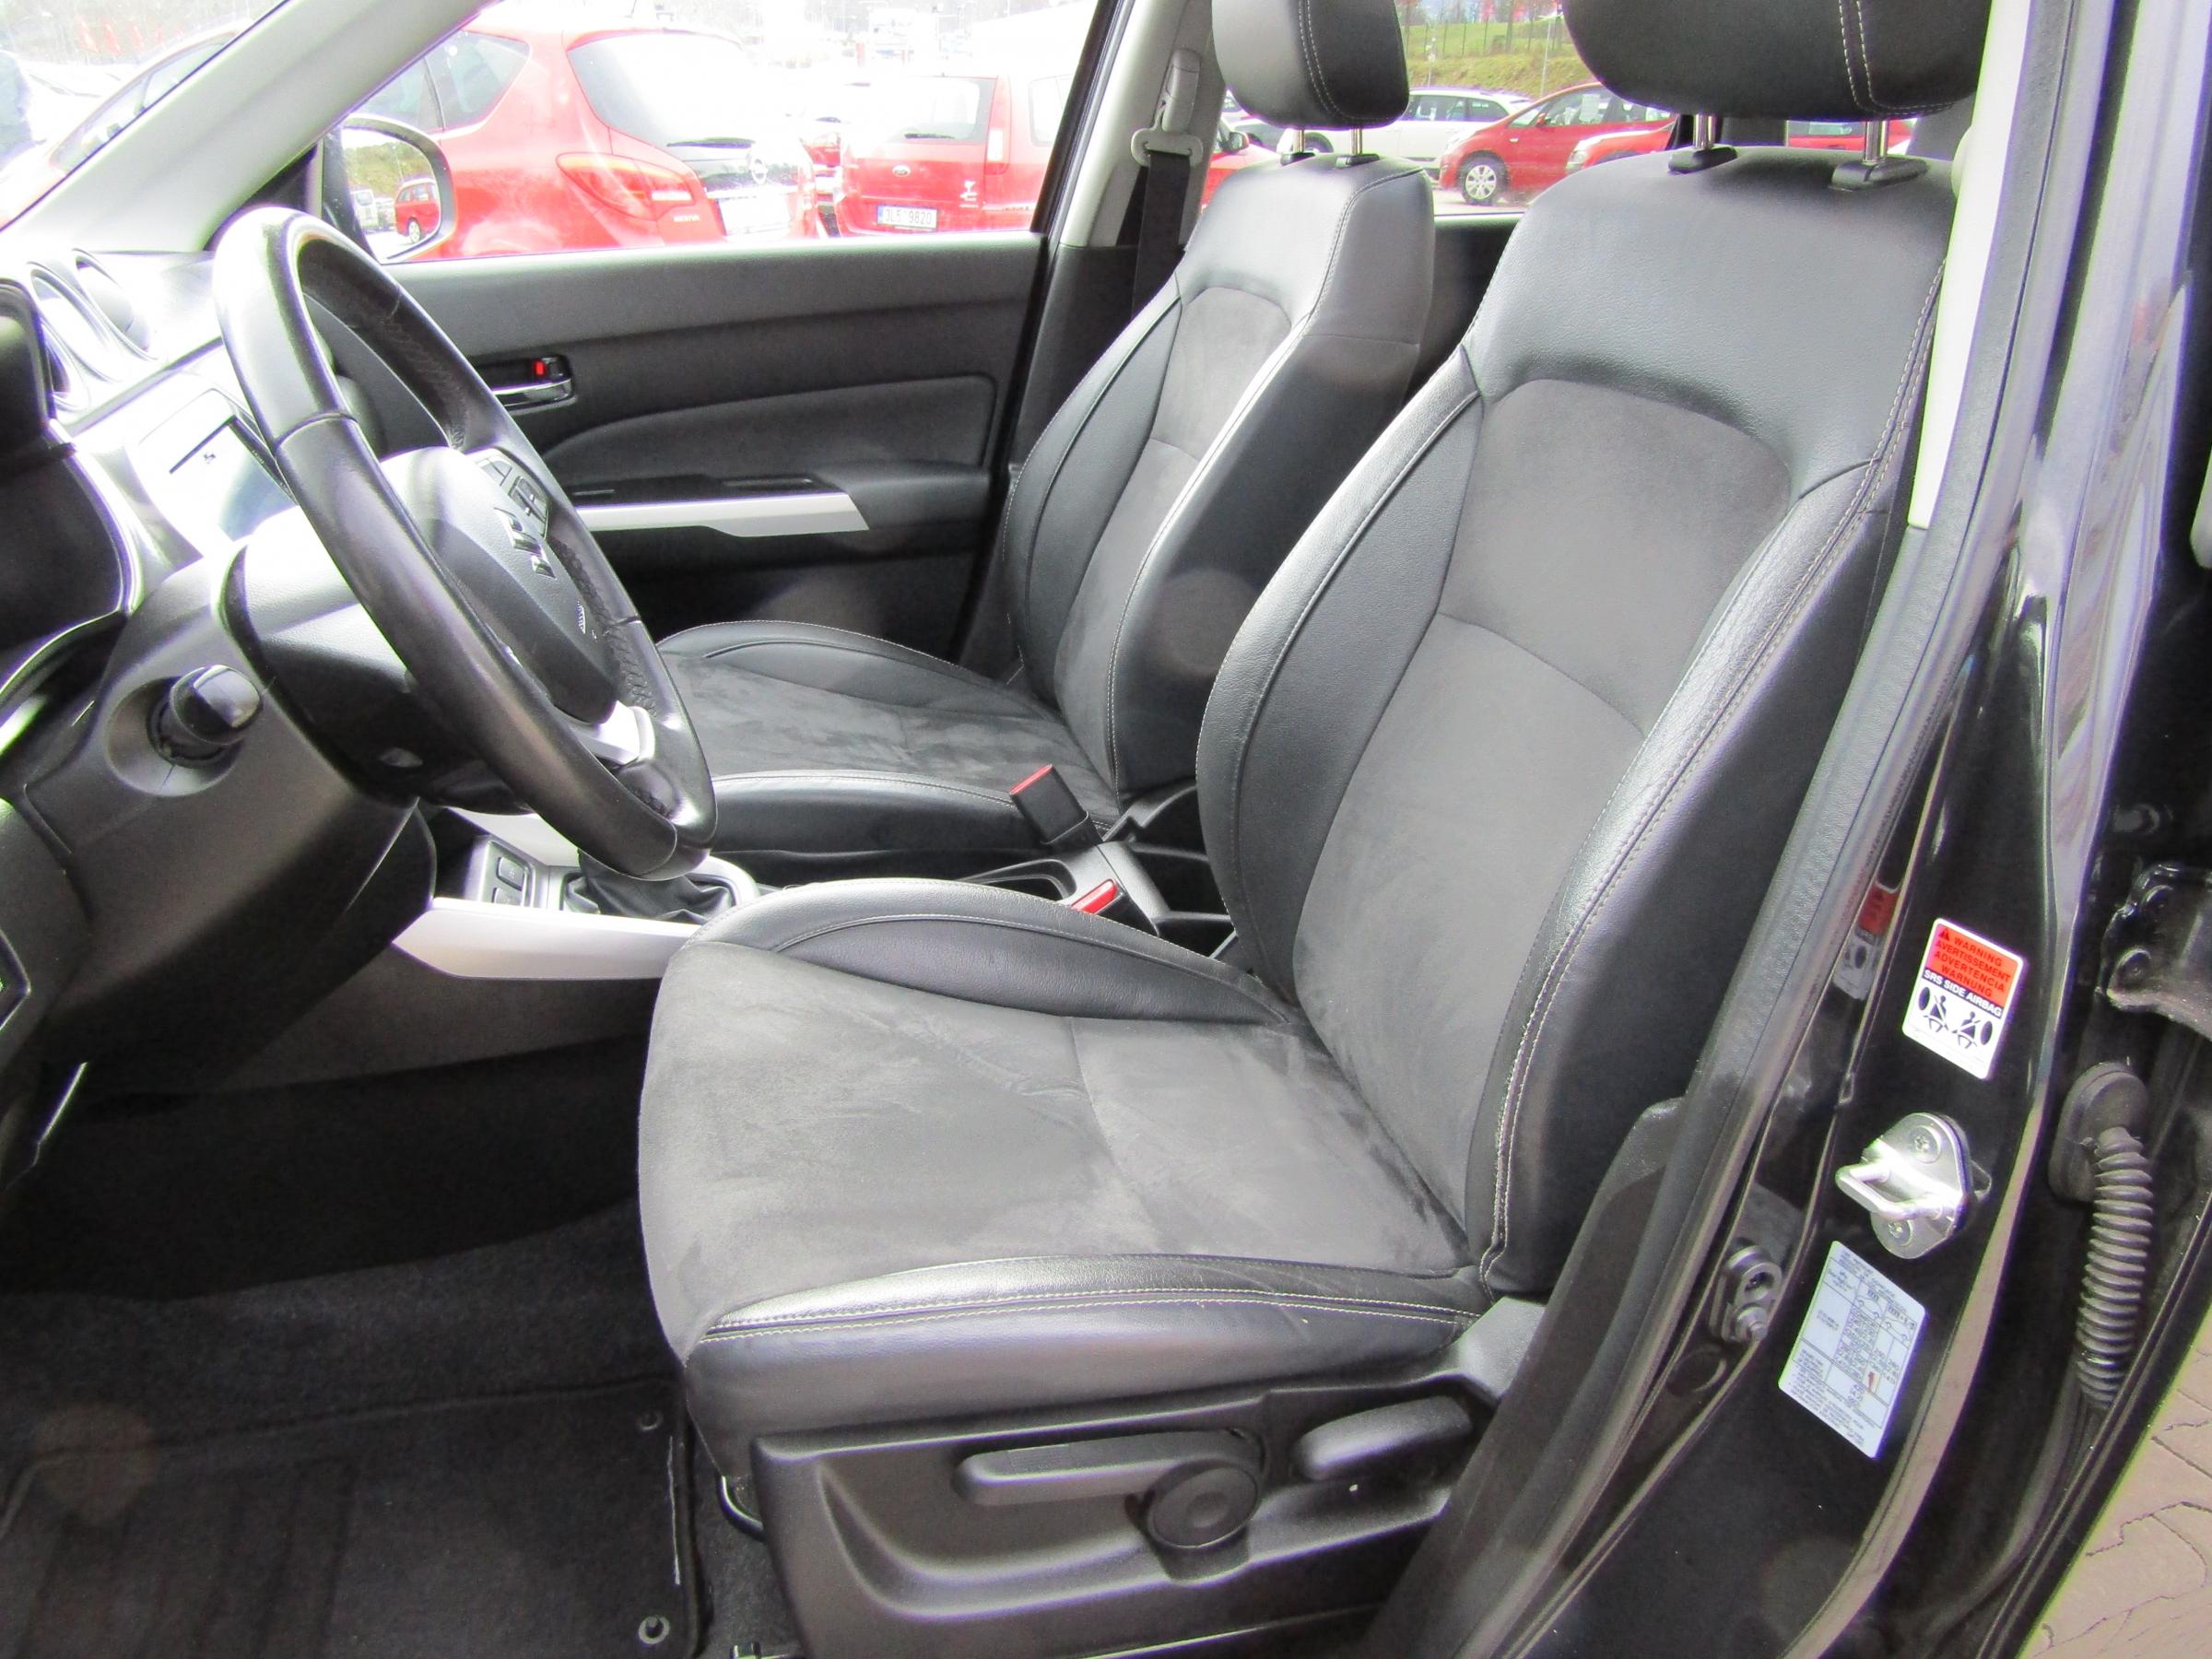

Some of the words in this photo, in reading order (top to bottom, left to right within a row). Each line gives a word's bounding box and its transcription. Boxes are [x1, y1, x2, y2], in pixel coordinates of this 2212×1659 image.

[1934, 950, 2005, 992] ADVERTENCIA
[1935, 940, 2010, 982] AVERTISSEMENT
[1954, 936, 2002, 967] WARNING
[1924, 969, 1944, 985] SRS
[1943, 979, 1967, 997] SIDE
[1966, 990, 2003, 1018] AIRBAG
[1941, 965, 1993, 997] WARNUNG
